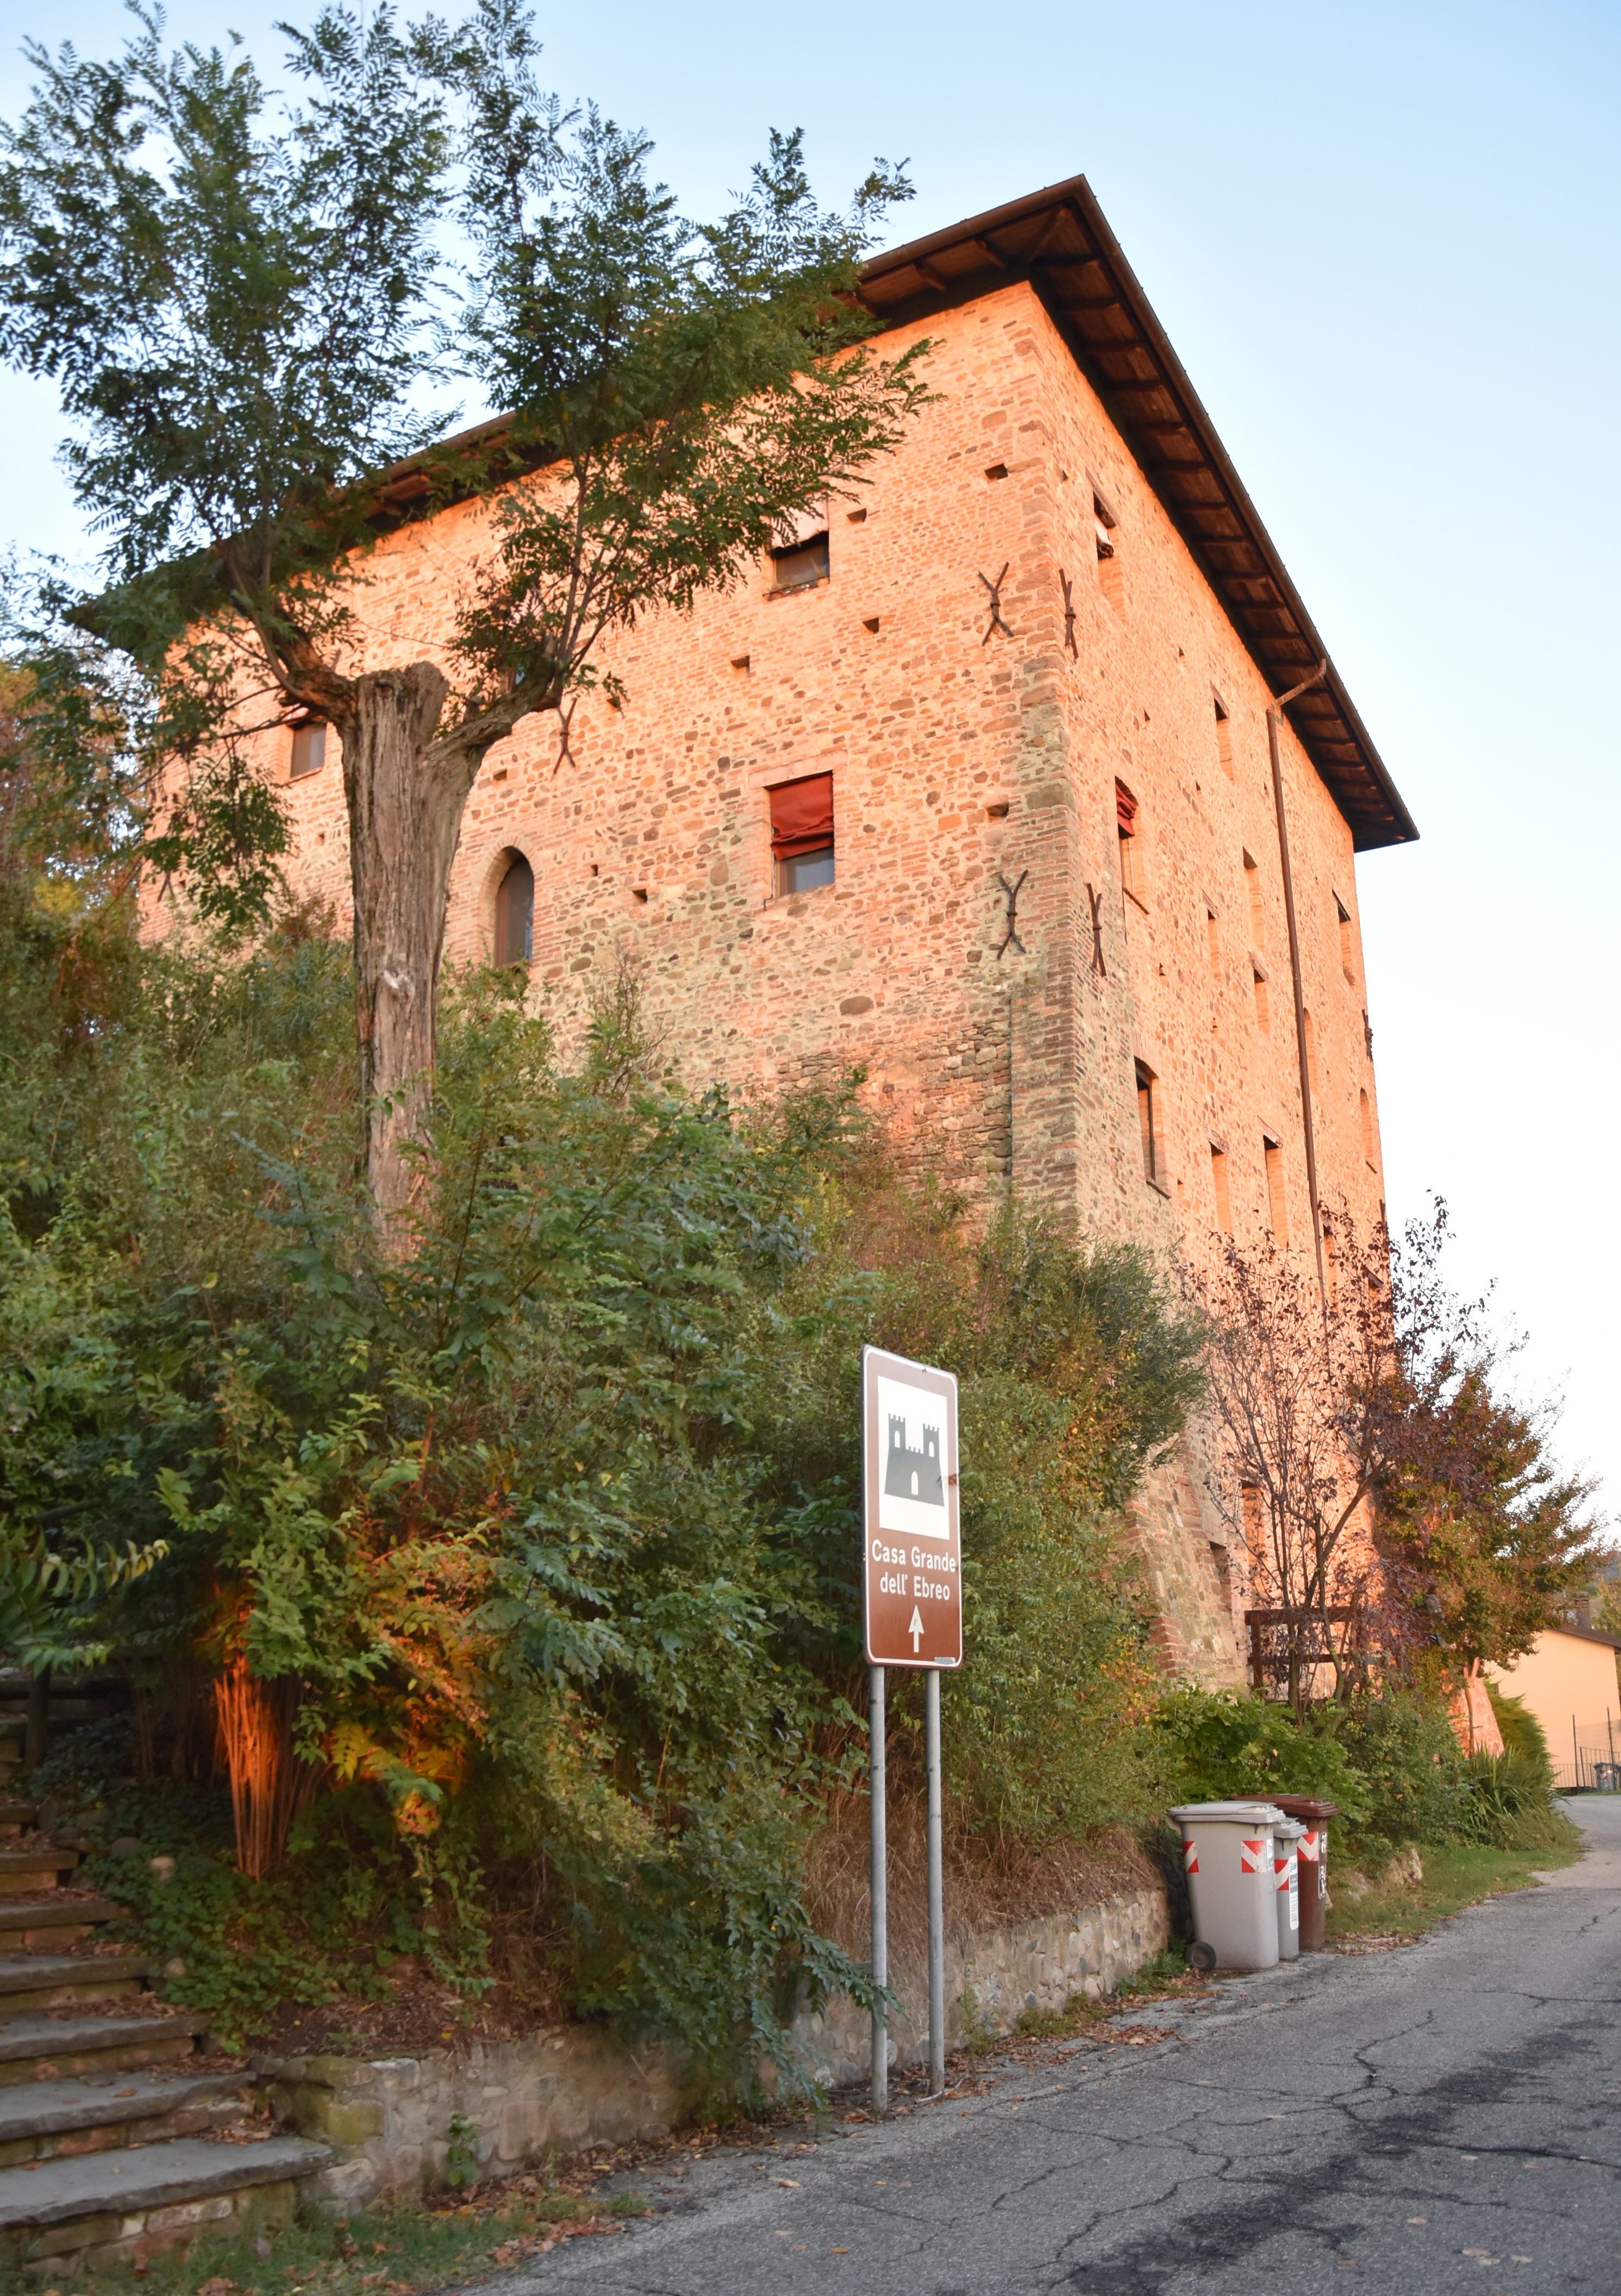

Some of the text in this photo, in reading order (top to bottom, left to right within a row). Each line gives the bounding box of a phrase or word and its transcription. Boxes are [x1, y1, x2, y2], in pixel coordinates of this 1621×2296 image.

[872, 1539, 956, 1573] Casa Grande
[880, 1571, 950, 1600] dell' Ebreo
